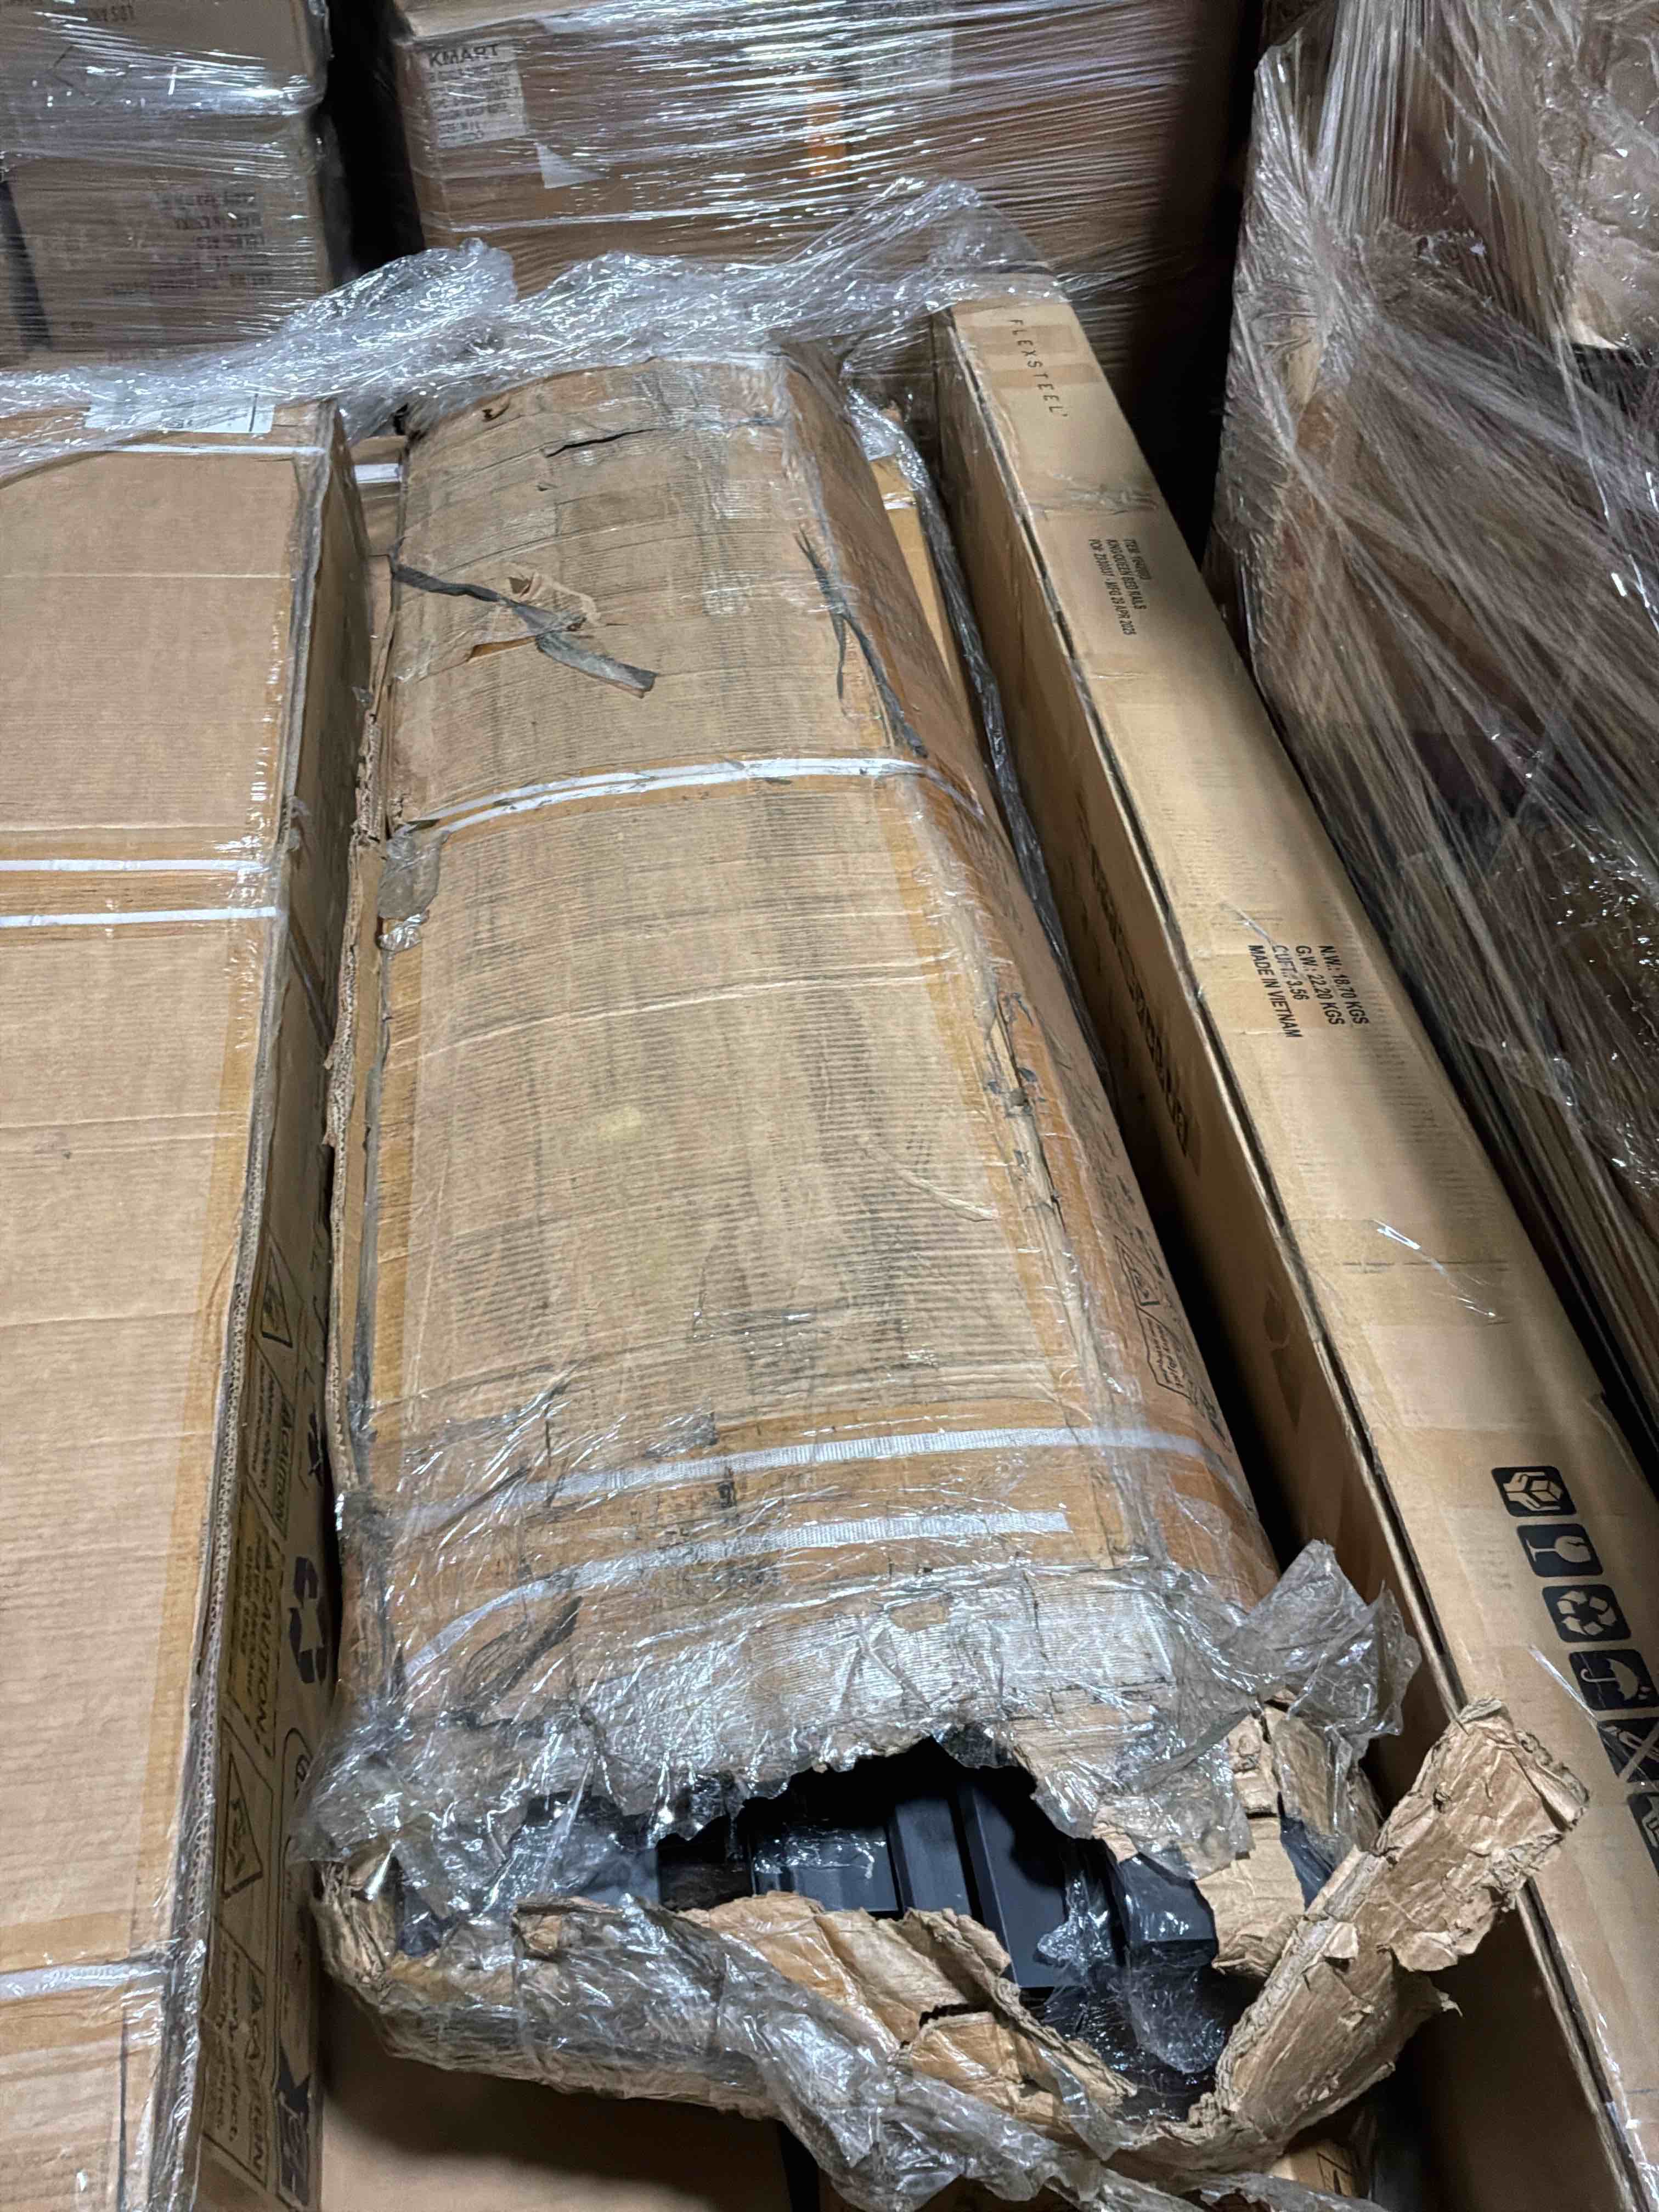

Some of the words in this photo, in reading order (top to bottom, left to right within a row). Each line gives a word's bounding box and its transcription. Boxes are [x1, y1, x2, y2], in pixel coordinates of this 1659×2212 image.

[429, 44, 499, 66] KMART
[1009, 319, 1064, 414] FLEXSTEEL
[1248, 945, 1273, 977] MADE
[1295, 945, 1319, 972] G.W.:
[1261, 978, 1281, 989] IN
[1286, 980, 1310, 1001] 3.56
[1307, 974, 1333, 1000] 22.20
[1318, 945, 1342, 970] N.W.:
[1333, 974, 1357, 998] 18.70
[1345, 1002, 1370, 1025] KGS
[1268, 992, 1303, 1038] VIETNAM
[1319, 1002, 1345, 1025] KGS
